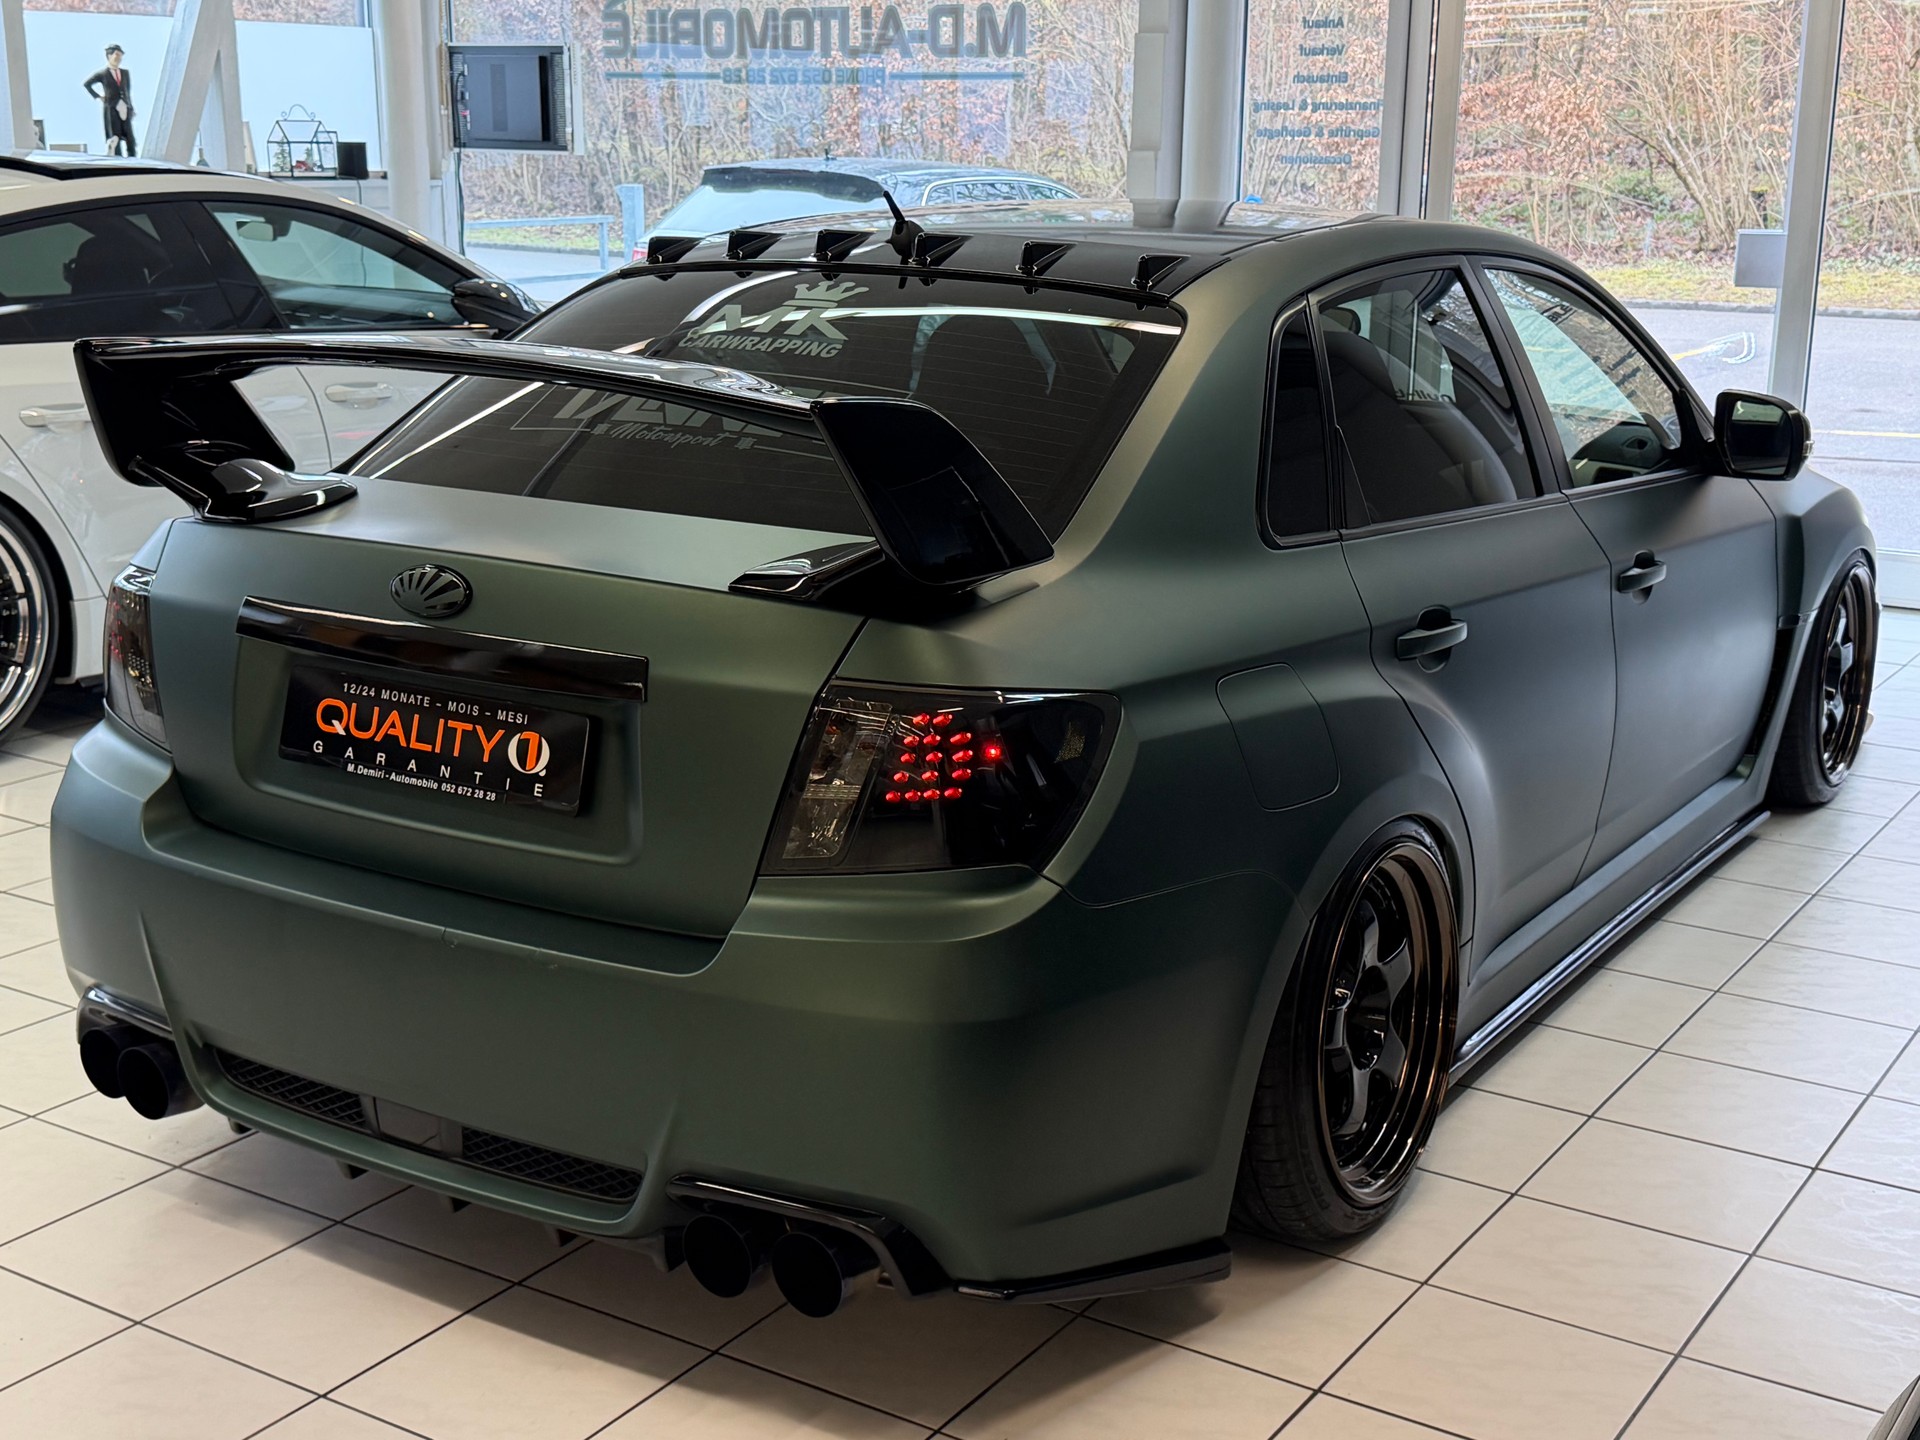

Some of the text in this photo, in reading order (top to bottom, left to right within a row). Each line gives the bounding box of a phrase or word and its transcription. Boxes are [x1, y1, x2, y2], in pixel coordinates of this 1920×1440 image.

[678, 334, 843, 358] CARWRAPPING
[609, 421, 739, 449] Motorsport
[343, 682, 376, 698] 12/24
[380, 688, 431, 708] MONATE
[447, 700, 480, 717] MOIS
[497, 709, 528, 726] MESI
[316, 698, 505, 763] QUALITY
[313, 740, 543, 798] GARANTIE
[441, 782, 455, 793] 052
[457, 785, 472, 797] 672
[474, 789, 484, 799] 28
[486, 791, 496, 802] 28
